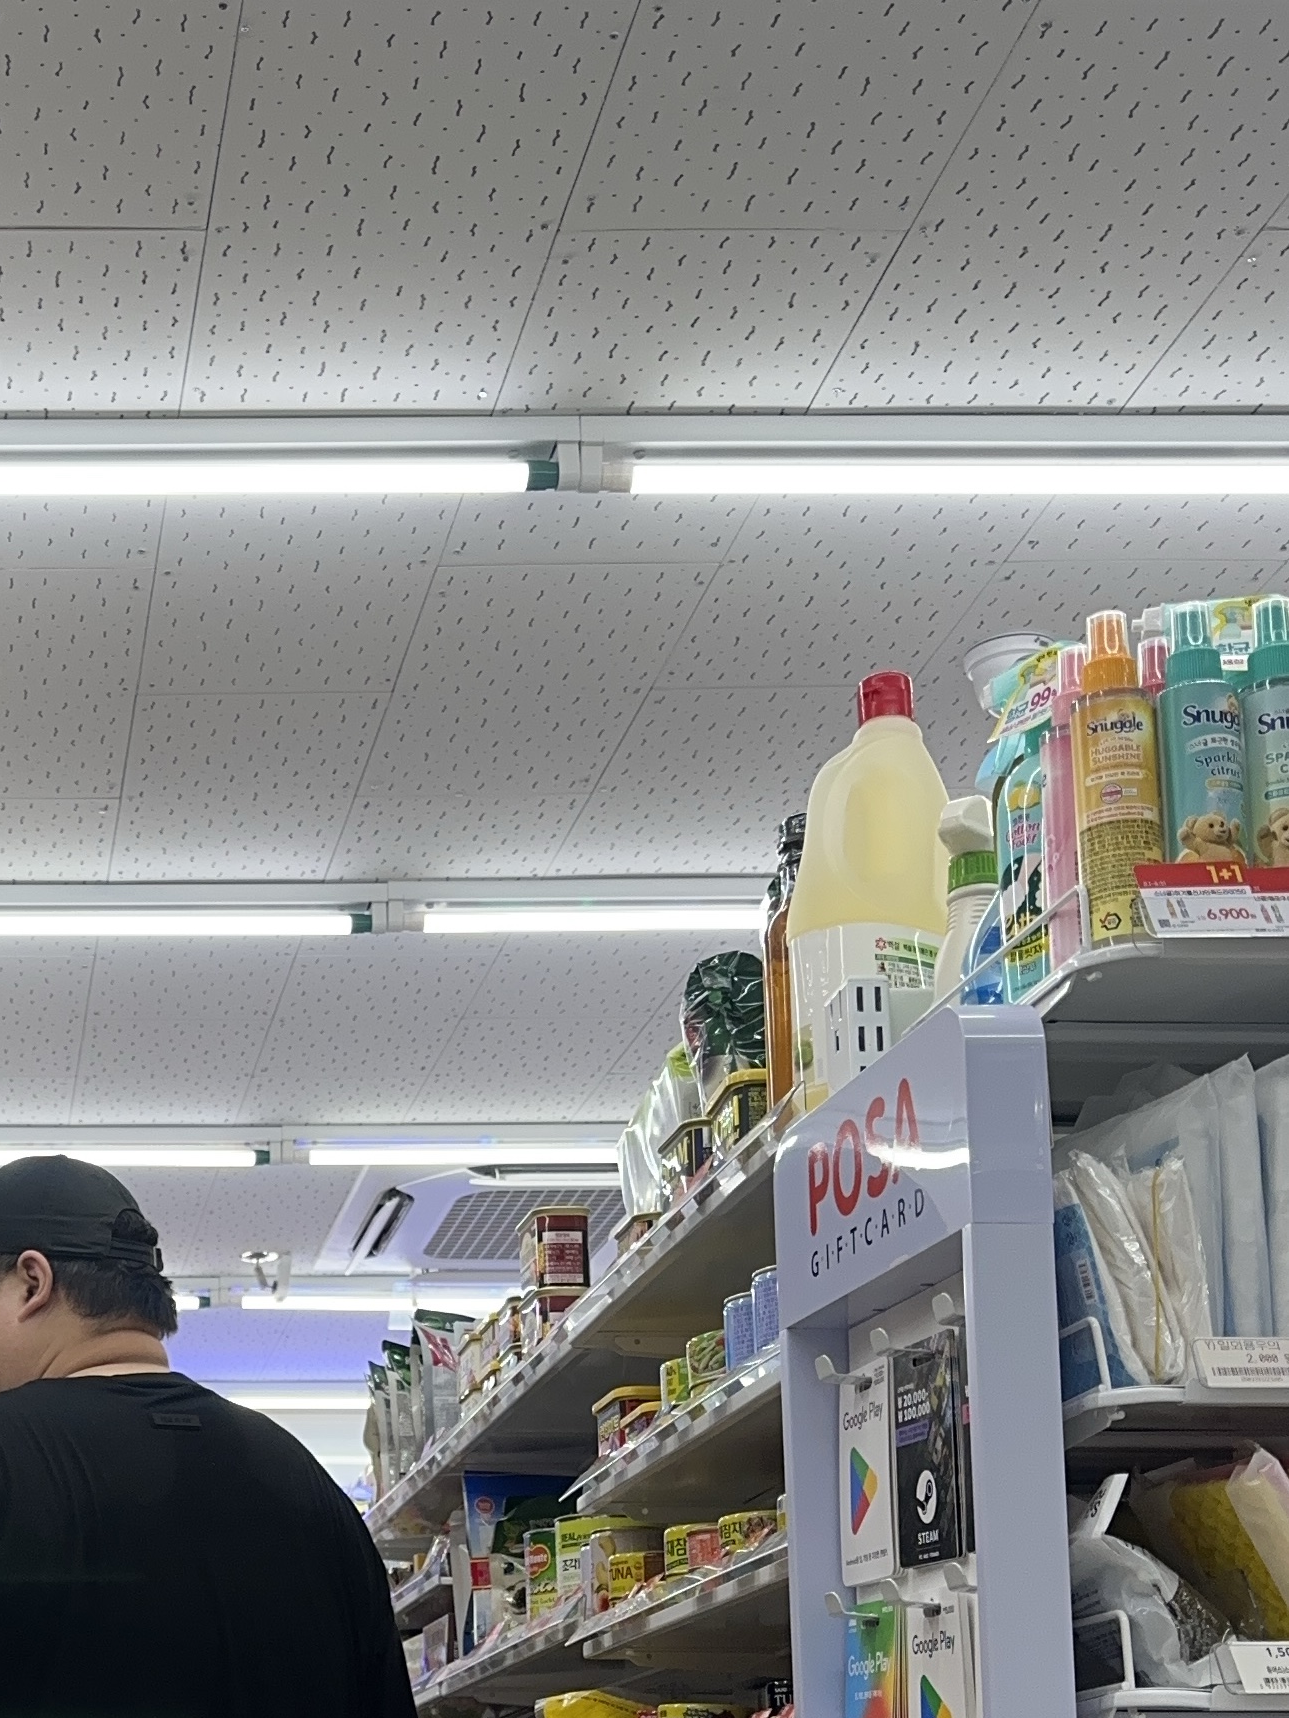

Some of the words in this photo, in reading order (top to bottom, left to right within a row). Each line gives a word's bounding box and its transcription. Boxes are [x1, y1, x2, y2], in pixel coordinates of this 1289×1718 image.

[1086, 716, 1144, 737] Snuggle
[1090, 743, 1142, 758] HUGGABLE
[1091, 752, 1142, 766] SUNSHINE
[1205, 864, 1244, 885] 1+1
[807, 1077, 923, 1237] POSA
[842, 1404, 868, 1432] Google
[868, 1400, 884, 1423] Play
[917, 1529, 940, 1546] STEAM
[912, 1632, 939, 1659] Google
[939, 1631, 955, 1655] Play
[847, 1655, 875, 1681] Google
[874, 1651, 890, 1677] Play
